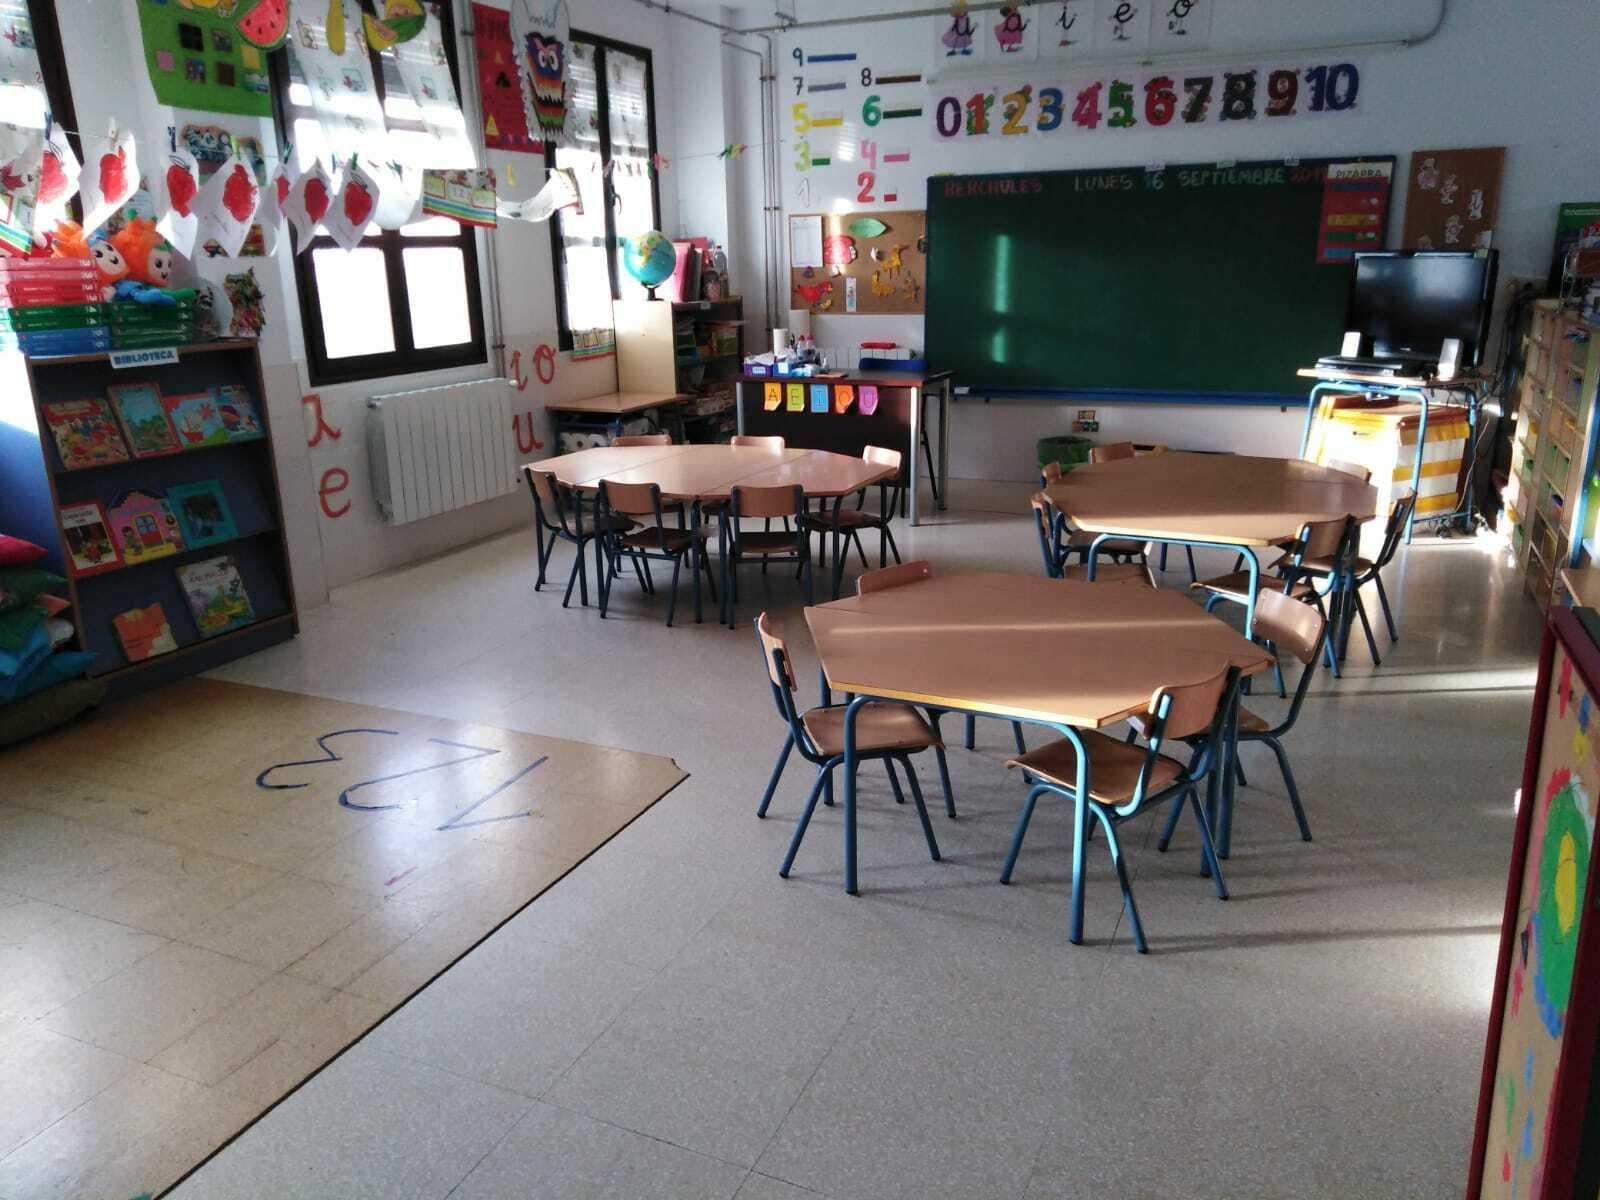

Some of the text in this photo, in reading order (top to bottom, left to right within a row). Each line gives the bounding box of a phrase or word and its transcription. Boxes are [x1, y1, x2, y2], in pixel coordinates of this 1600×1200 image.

[793, 48, 804, 67] 9
[793, 76, 804, 96] 7
[861, 67, 873, 88] 8
[862, 95, 882, 127] 6
[936, 96, 962, 138] 0
[1002, 90, 1029, 135] 2
[1037, 87, 1064, 131] 3
[1071, 83, 1102, 129] 4
[1107, 80, 1135, 128] 5
[1145, 76, 1177, 126] 6
[1183, 76, 1213, 123] 7
[1222, 72, 1257, 120] 8
[1266, 70, 1299, 117] 9
[1305, 63, 1360, 112] 10
[792, 102, 811, 133] 5
[794, 140, 811, 172] 3
[860, 138, 878, 170] 4
[857, 171, 876, 204] 2
[113, 350, 175, 365] BIBLIOTECA
[512, 411, 544, 454] u
[319, 468, 352, 518] e
